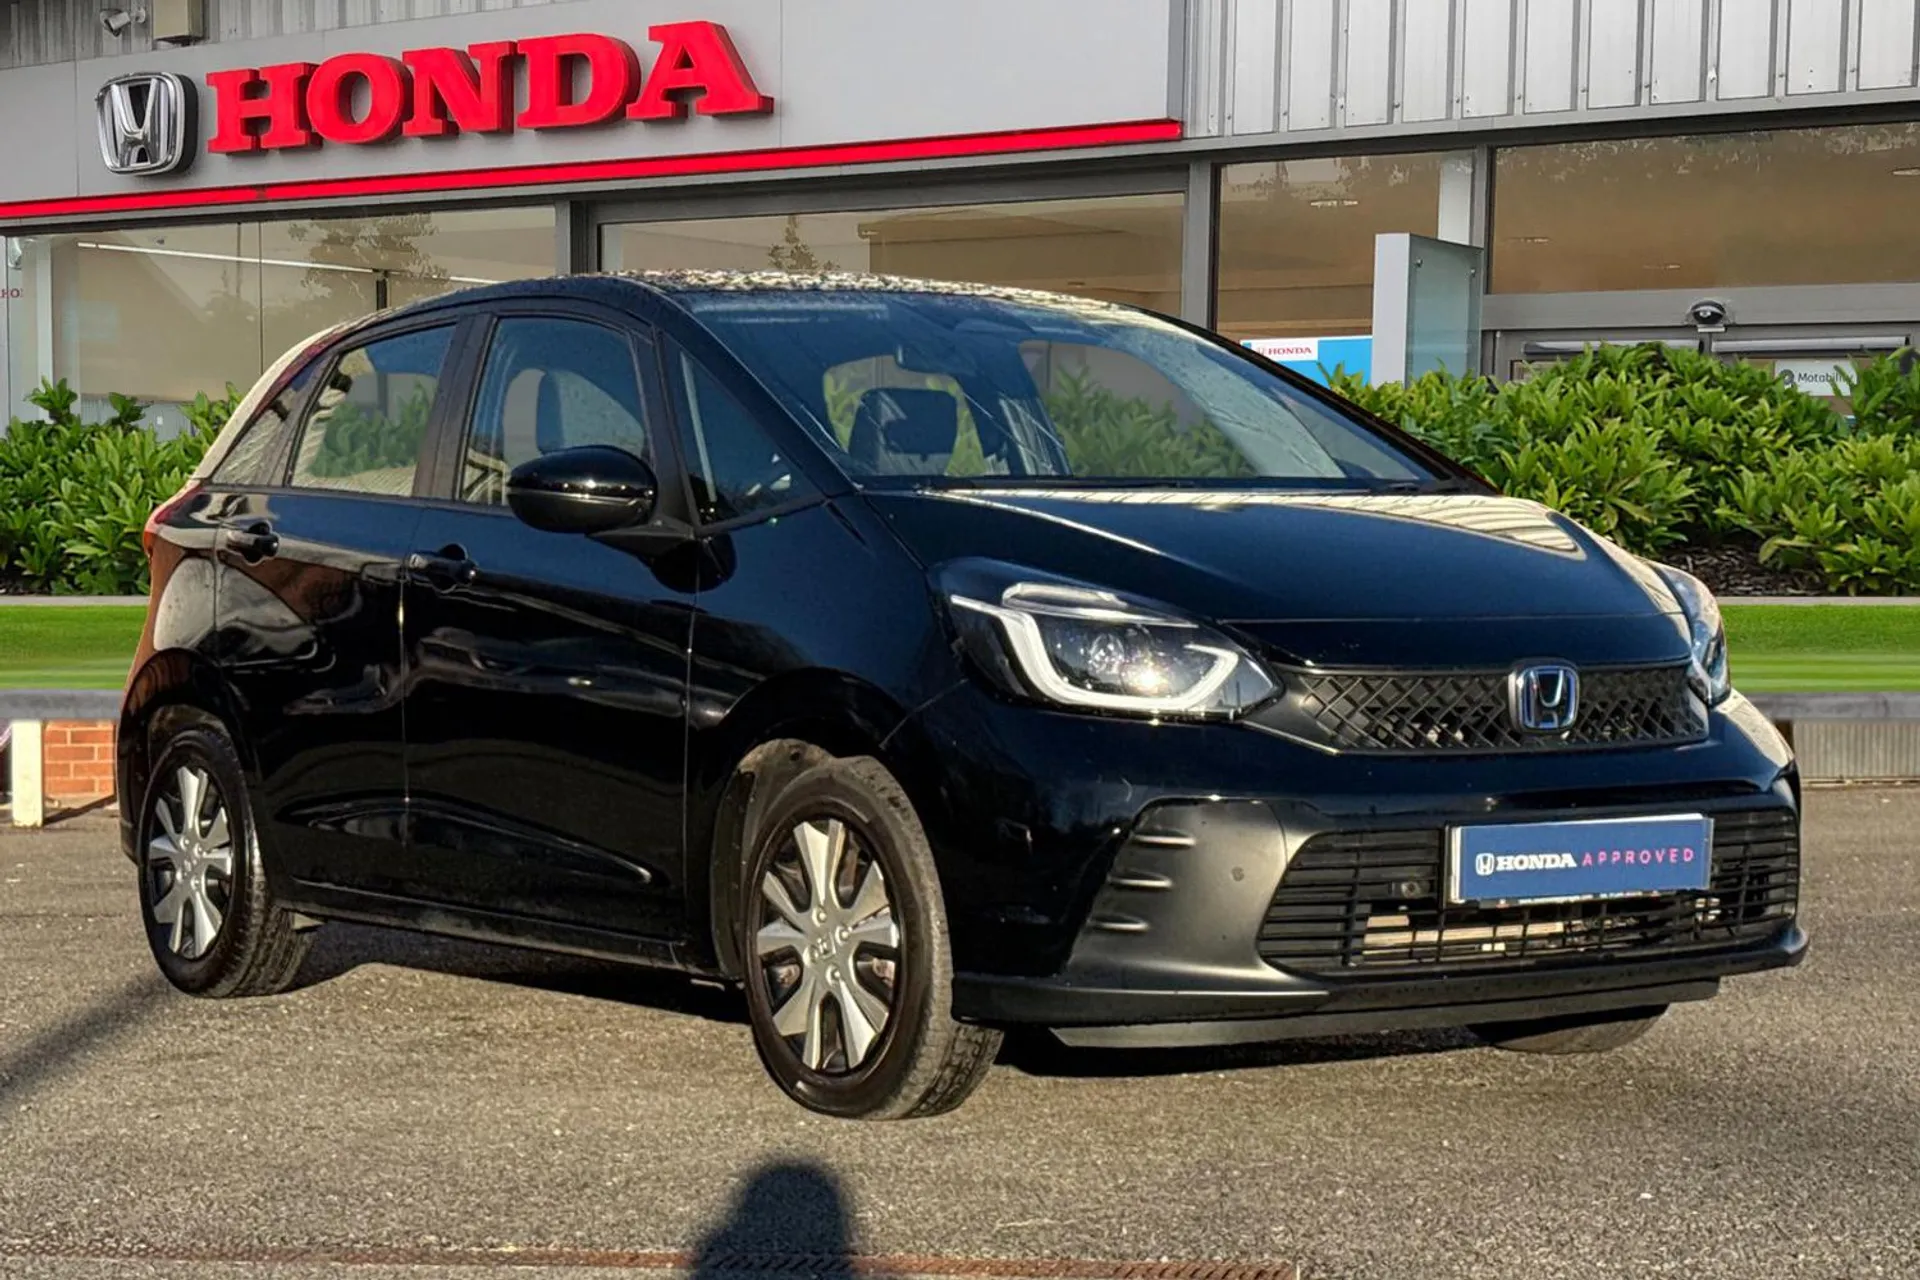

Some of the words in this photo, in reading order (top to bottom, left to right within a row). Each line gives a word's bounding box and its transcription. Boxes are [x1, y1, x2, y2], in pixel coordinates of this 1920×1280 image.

[206, 21, 774, 154] HONDA
[0, 287, 24, 299] HO
[1267, 346, 1312, 356] HONDA
[1797, 371, 1853, 385] Motabli
[1495, 853, 1577, 871] HONDA
[1582, 847, 1694, 866] APPROVED
